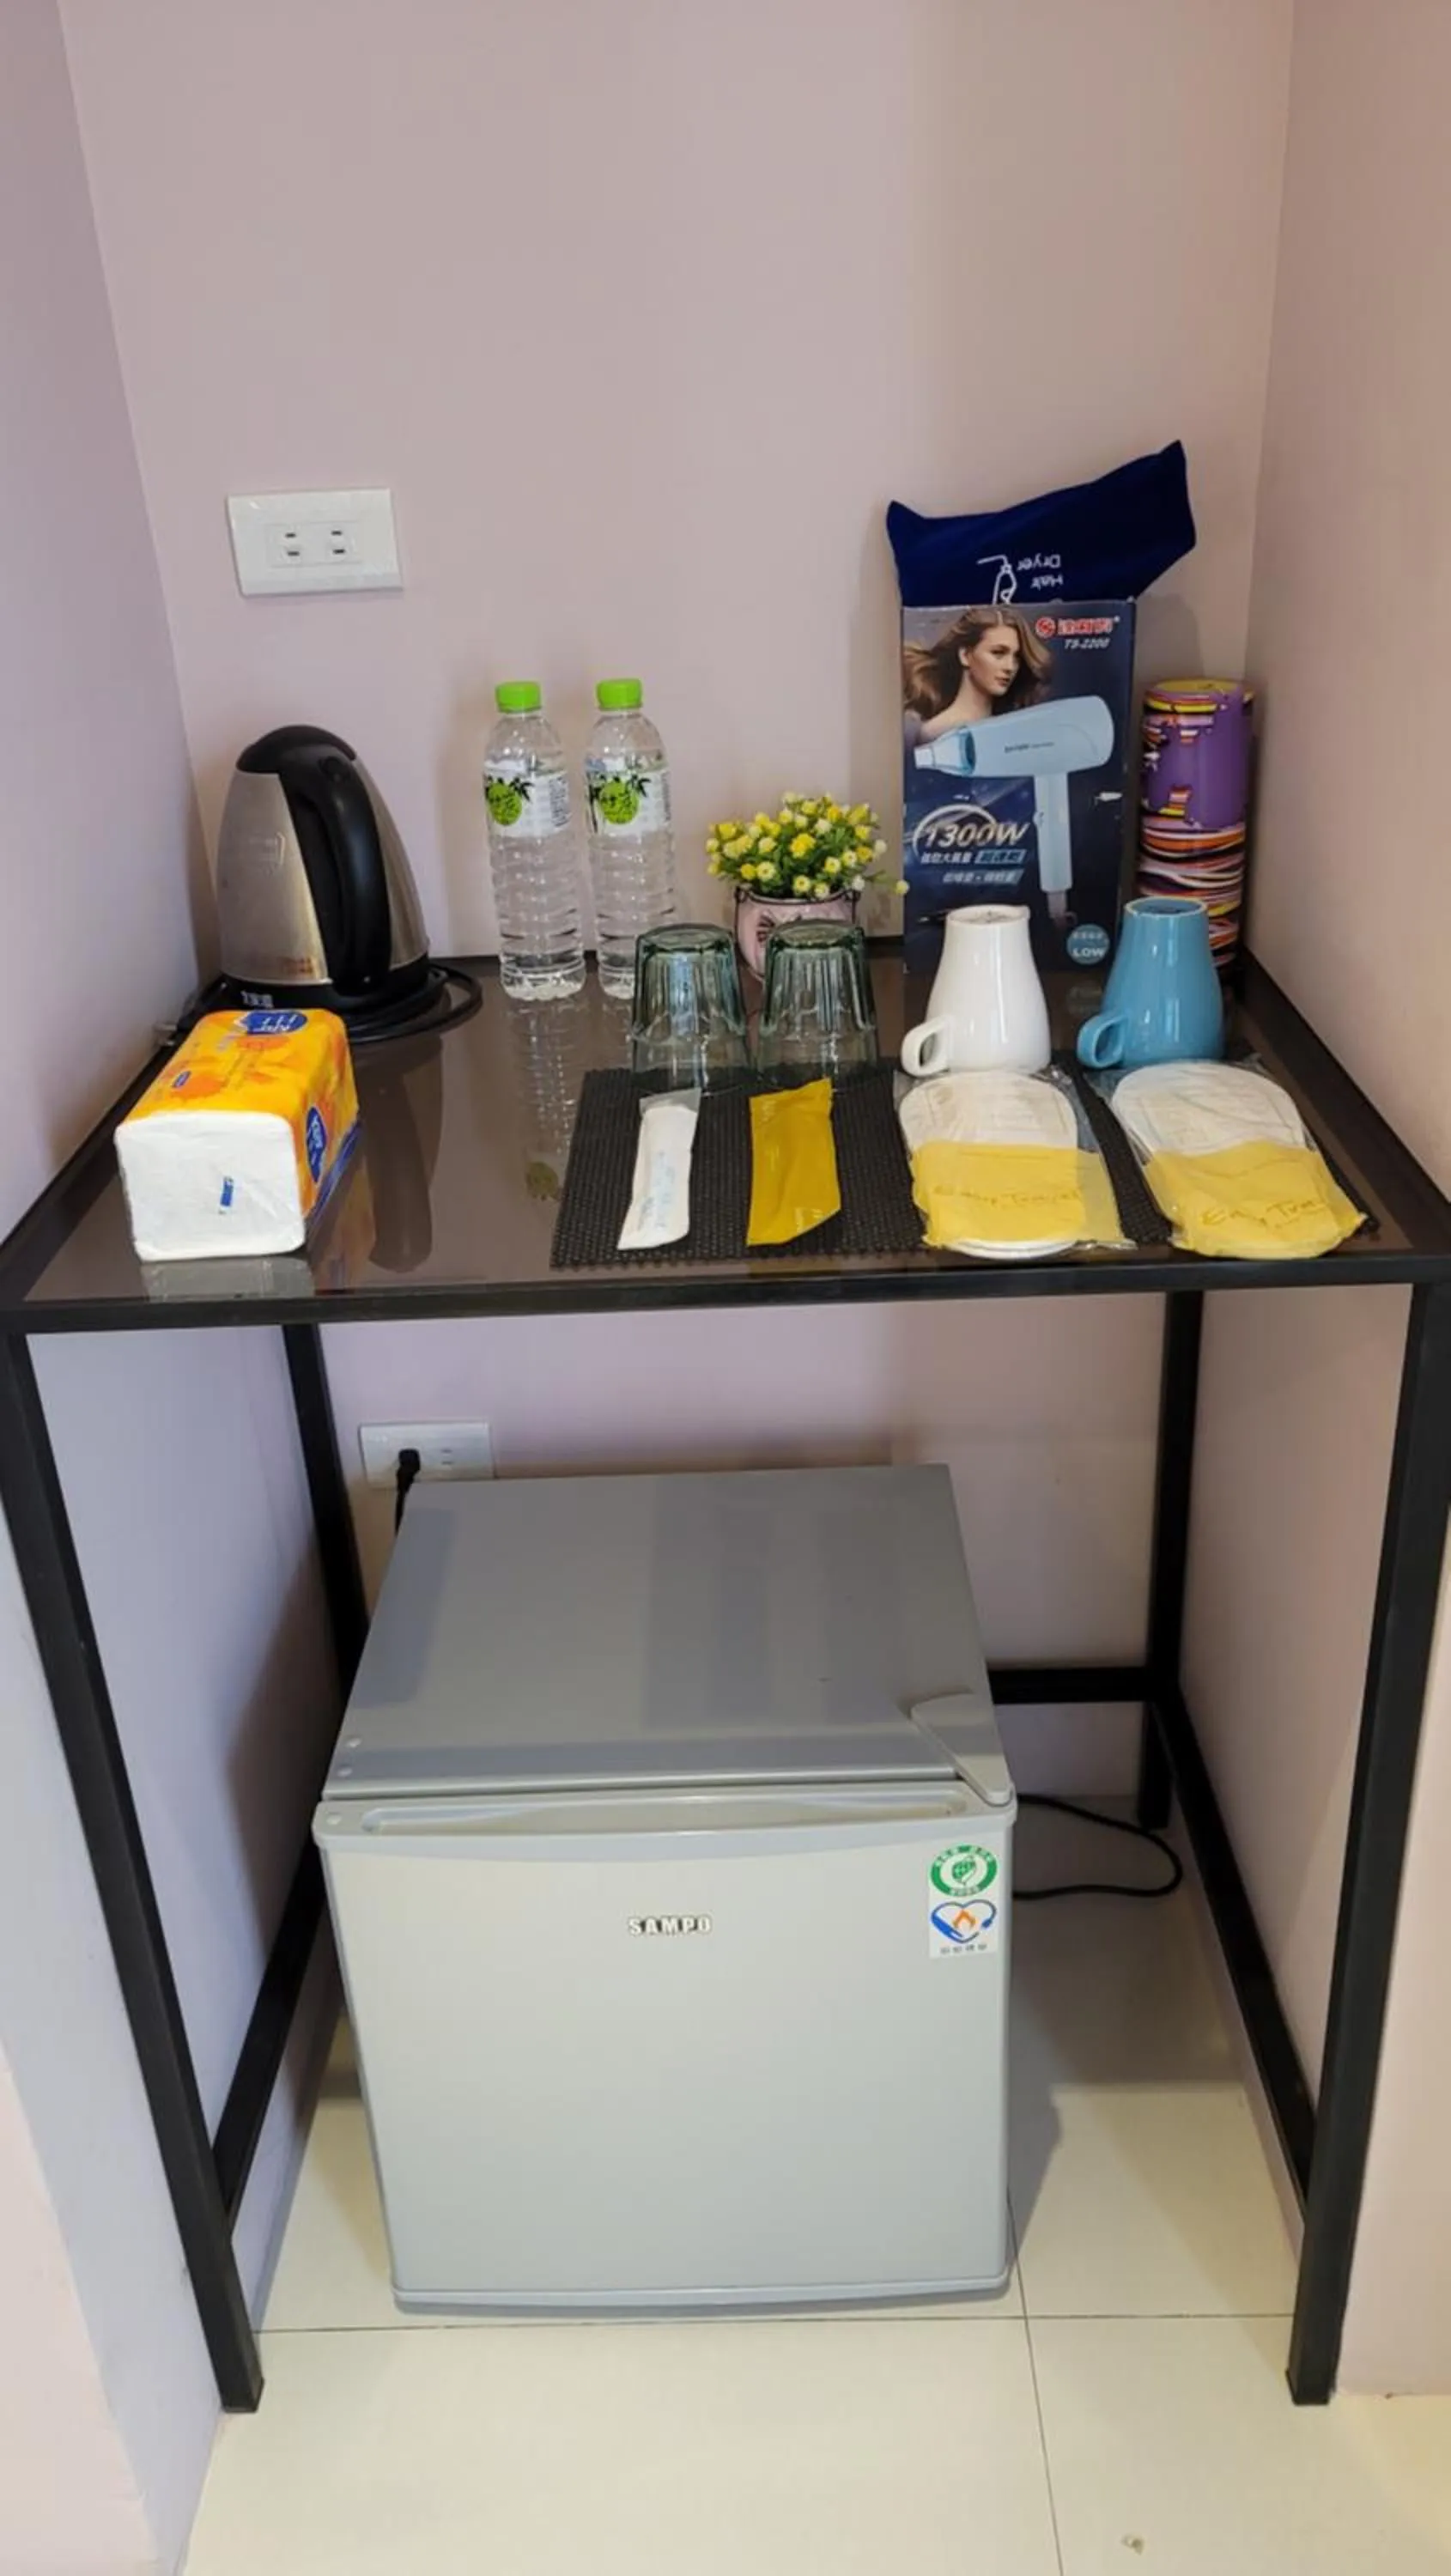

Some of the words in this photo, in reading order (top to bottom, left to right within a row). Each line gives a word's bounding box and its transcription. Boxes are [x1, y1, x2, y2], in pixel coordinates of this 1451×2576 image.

[1017, 552, 1061, 571] Dryer
[924, 822, 1030, 848] 1300W
[1072, 947, 1105, 958] LOW
[628, 1915, 713, 1935] SAMPO
